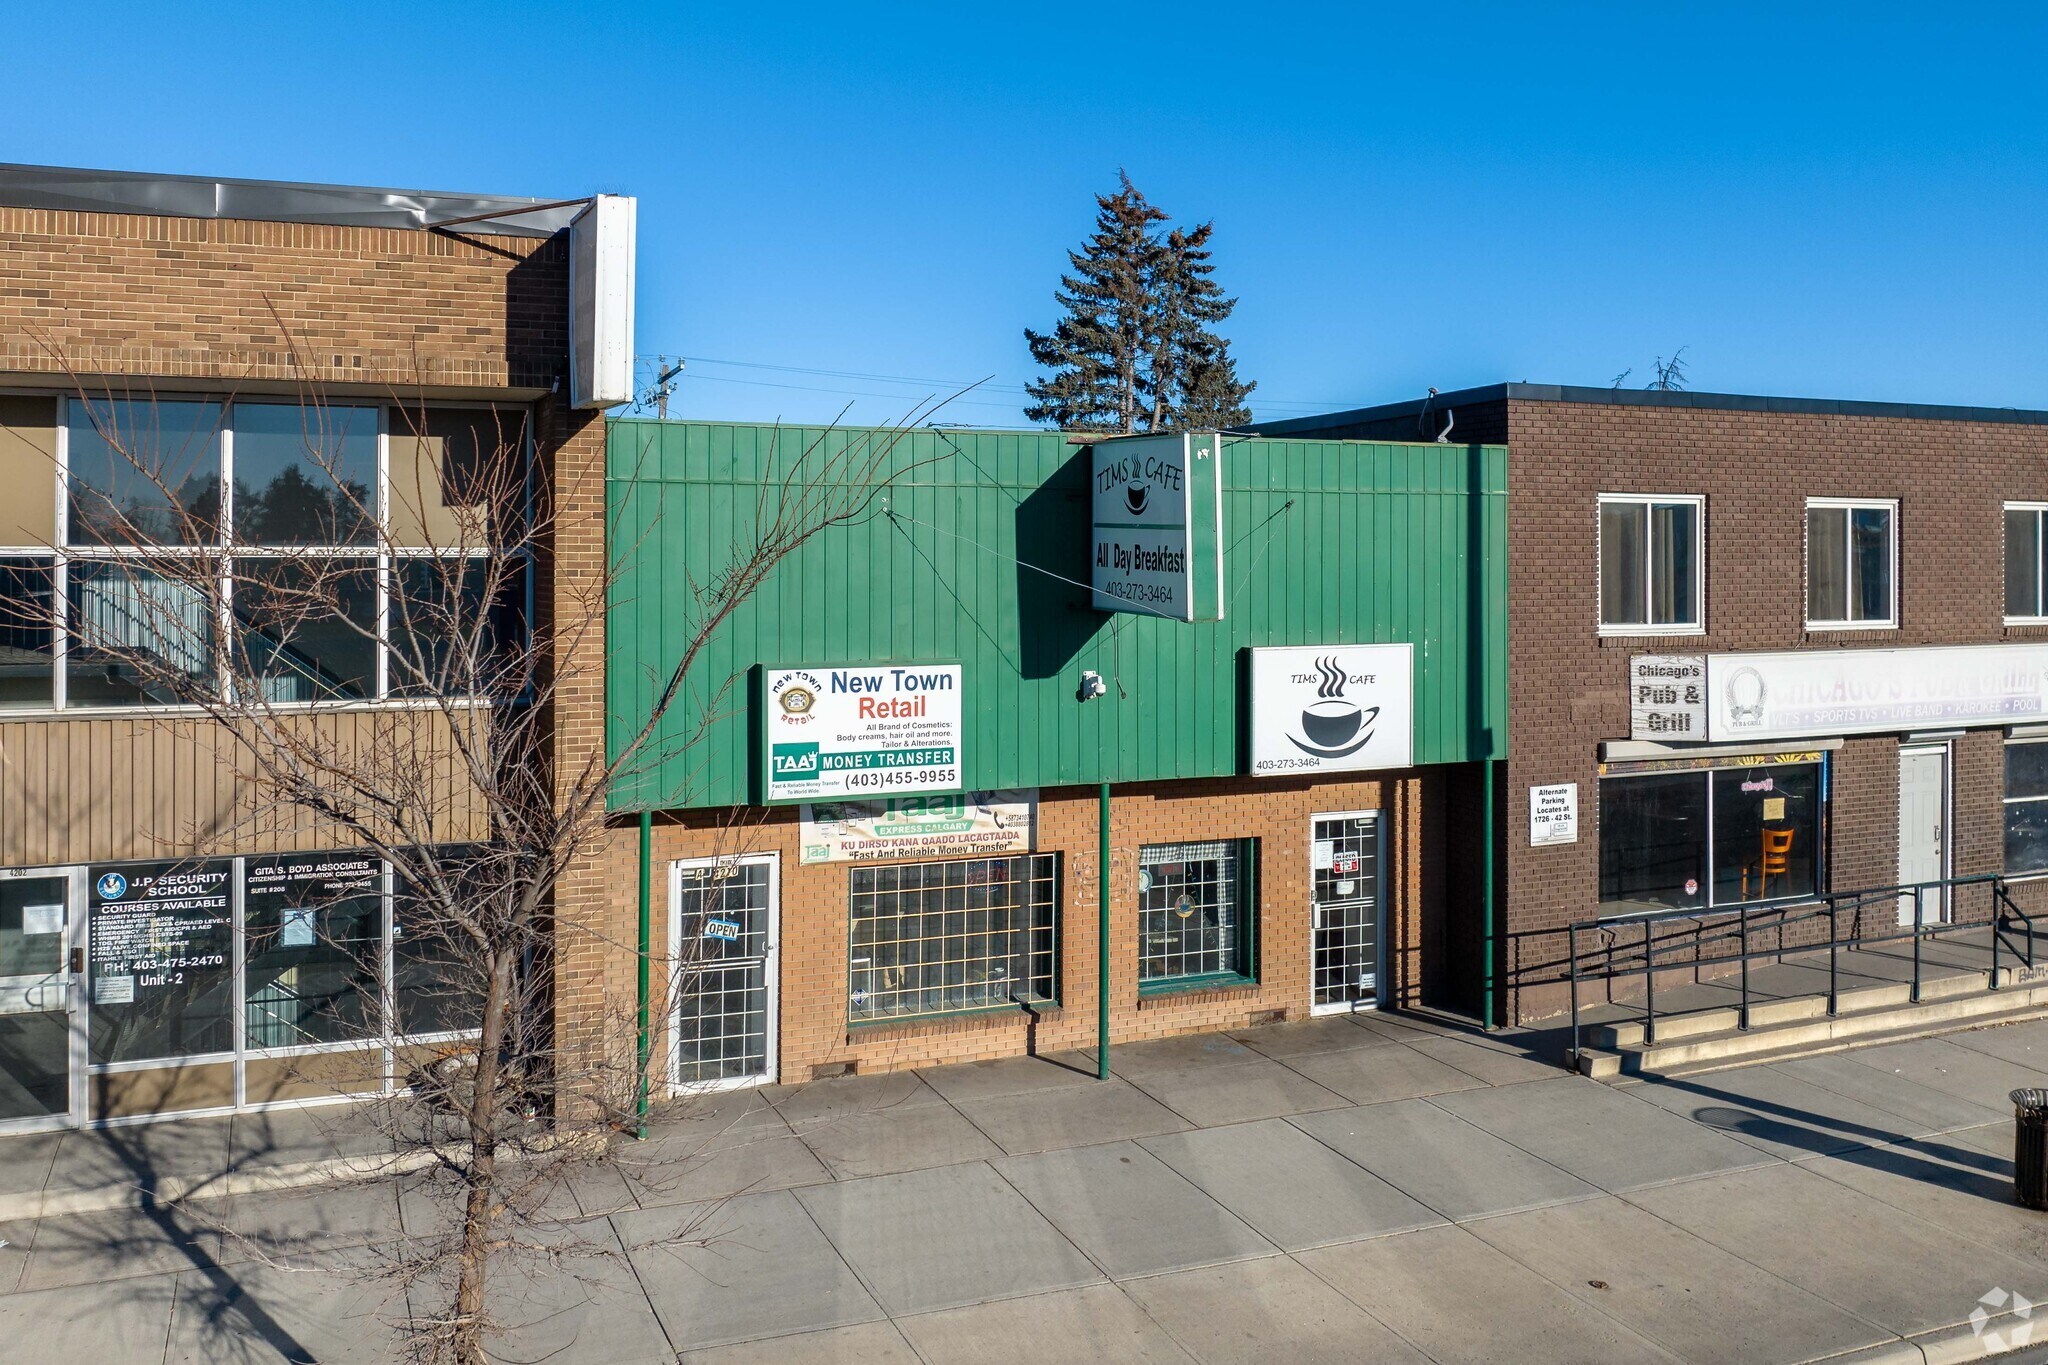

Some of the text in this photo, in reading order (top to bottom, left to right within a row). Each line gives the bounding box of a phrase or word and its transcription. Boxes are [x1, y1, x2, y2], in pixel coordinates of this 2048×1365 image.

[1097, 456, 1183, 494] TIMS CAFE
[1096, 543, 1185, 576] All Day Breakfast
[1105, 580, 1173, 604] 403-273-3464
[1638, 664, 1700, 679] Chicago's
[831, 669, 953, 694] New Town
[1291, 674, 1377, 685] TIMS CAFE
[1684, 685, 1700, 704] &
[859, 695, 926, 719] Retail
[1813, 709, 1856, 723] SPORTS
[1859, 708, 1878, 720] TVS
[1891, 706, 1913, 719] LIVE
[1915, 704, 1943, 717] BAND
[1955, 700, 2001, 715] KAROKEE
[2012, 699, 2039, 711] POOL
[866, 723, 877, 731] All
[878, 722, 901, 731] Brand
[912, 721, 953, 730] Cosmetics:
[837, 734, 857, 743] Body
[858, 733, 888, 742] creams,
[911, 739, 953, 747] Alterations.
[822, 750, 951, 770] MONEY TRANSFER
[1256, 757, 1321, 770] 403-273-3464
[845, 769, 956, 790] (403)455-9955
[1538, 788, 1568, 796] Alternate
[1541, 797, 1565, 805] Parking
[1536, 806, 1562, 814] Locates
[879, 821, 969, 836] EXPRESS CALGARY
[841, 832, 1020, 850] KU DIRSO KANA QAADO LACAGTAADA
[876, 849, 896, 859] And
[898, 847, 936, 858] Reliable
[938, 845, 968, 856] Money
[248, 875, 285, 883] CITIZENSHIP
[294, 872, 334, 880] IMMIGRATION
[335, 869, 378, 877] CONSULTANTS
[255, 861, 369, 876] GITA S. BOYD ASSOCIATES
[158, 872, 228, 886] SECURITY
[148, 885, 207, 896] SCHOOL
[101, 899, 226, 914] COURSES AVAILABLE
[97, 916, 174, 926] PRIVATE INVESTIGATOR
[98, 923, 134, 931] STANDARD
[709, 923, 737, 938] OPEN
[104, 955, 223, 972] PH: 403-475-2470
[140, 974, 165, 986] Unit
[174, 973, 183, 984] 2
